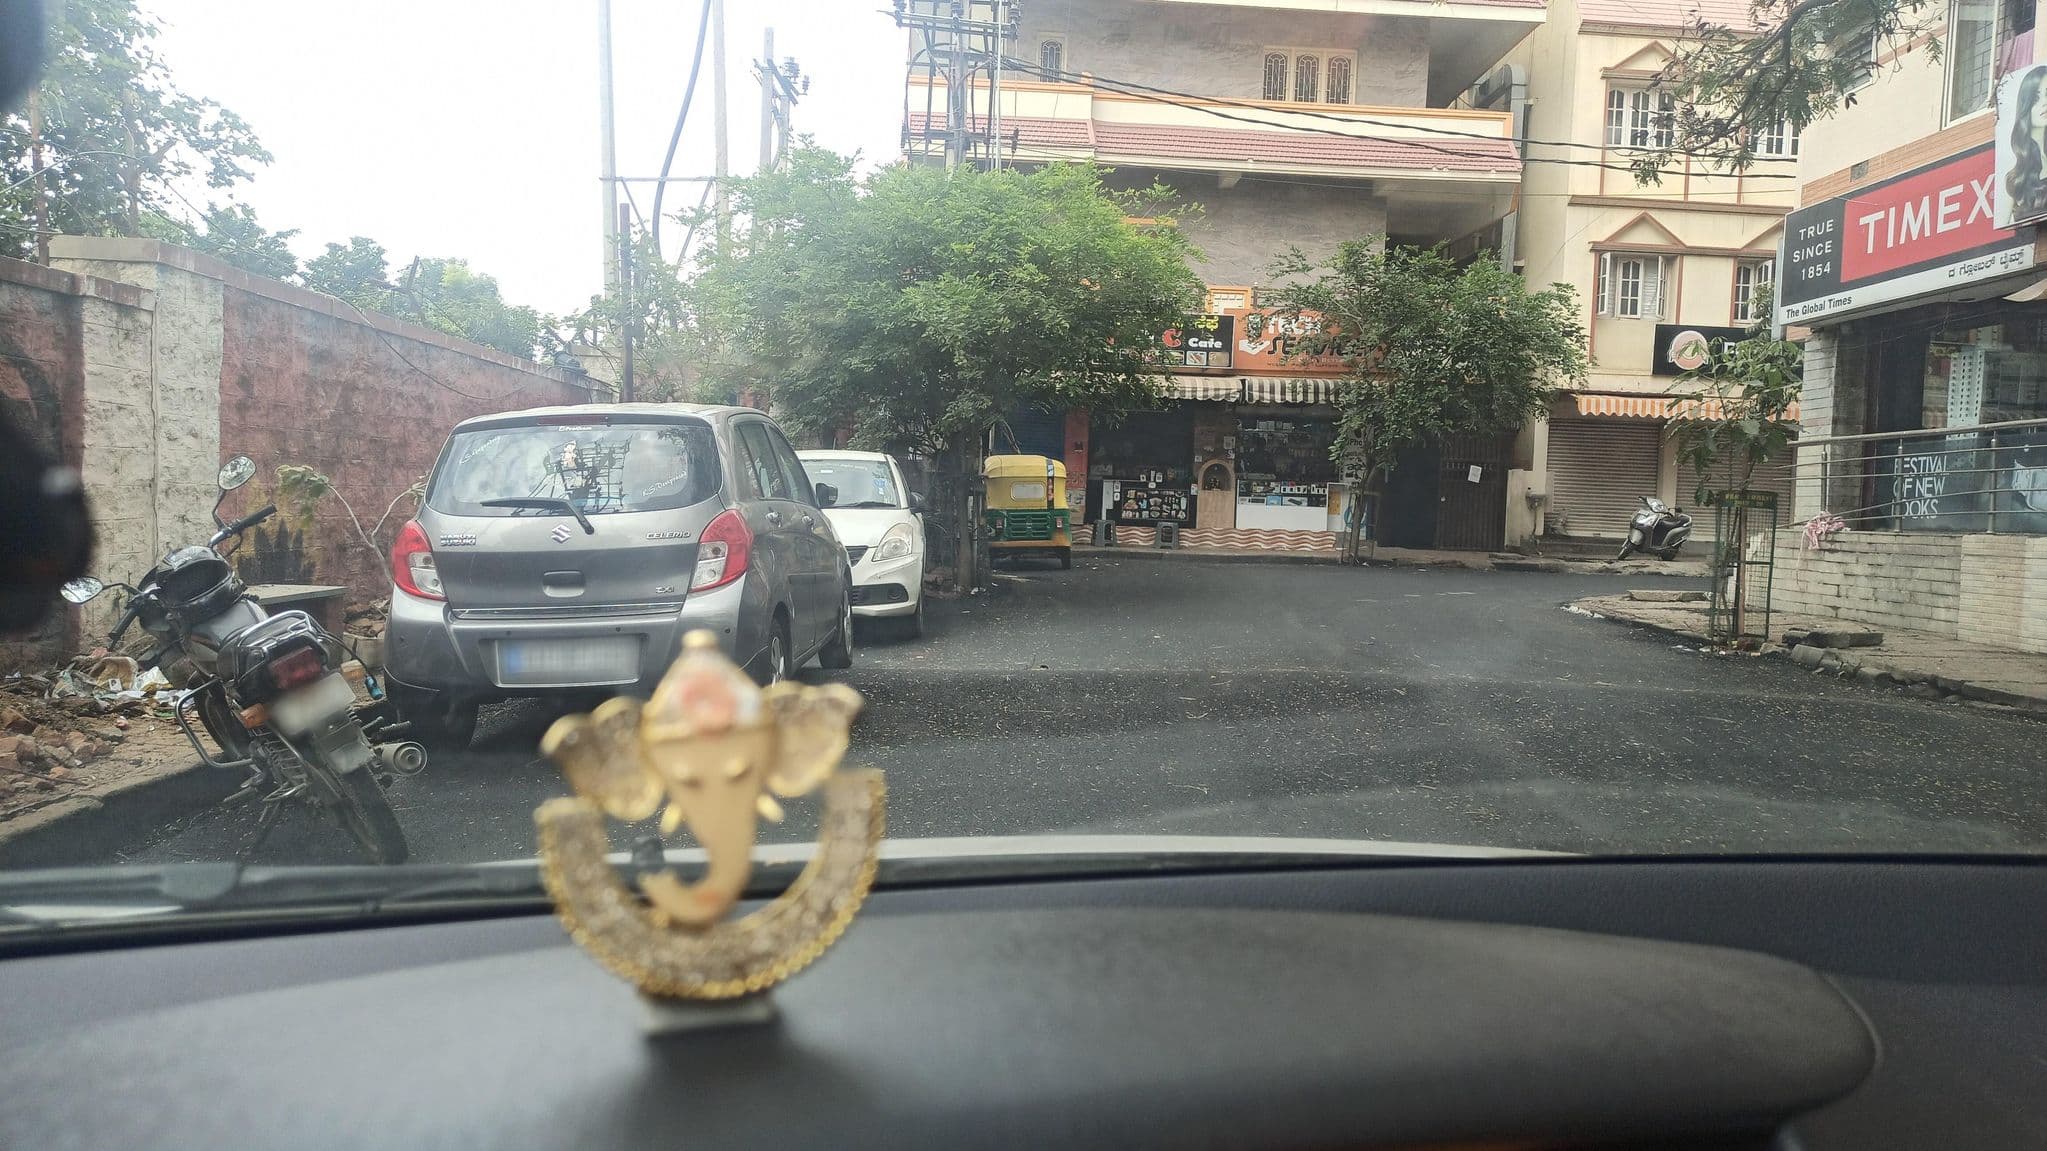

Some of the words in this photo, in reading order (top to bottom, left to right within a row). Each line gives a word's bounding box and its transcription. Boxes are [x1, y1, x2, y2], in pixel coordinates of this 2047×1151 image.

[1859, 173, 1995, 254] TIMEX
[1799, 219, 1835, 241] TRUE
[1792, 241, 1833, 263] SINCE
[1801, 261, 1831, 281] 1854
[1786, 308, 1800, 319] The
[1801, 302, 1826, 316] Global
[1827, 295, 1853, 310] Times
[1188, 337, 1223, 349] Cafe
[1915, 476, 1946, 498] NEW
